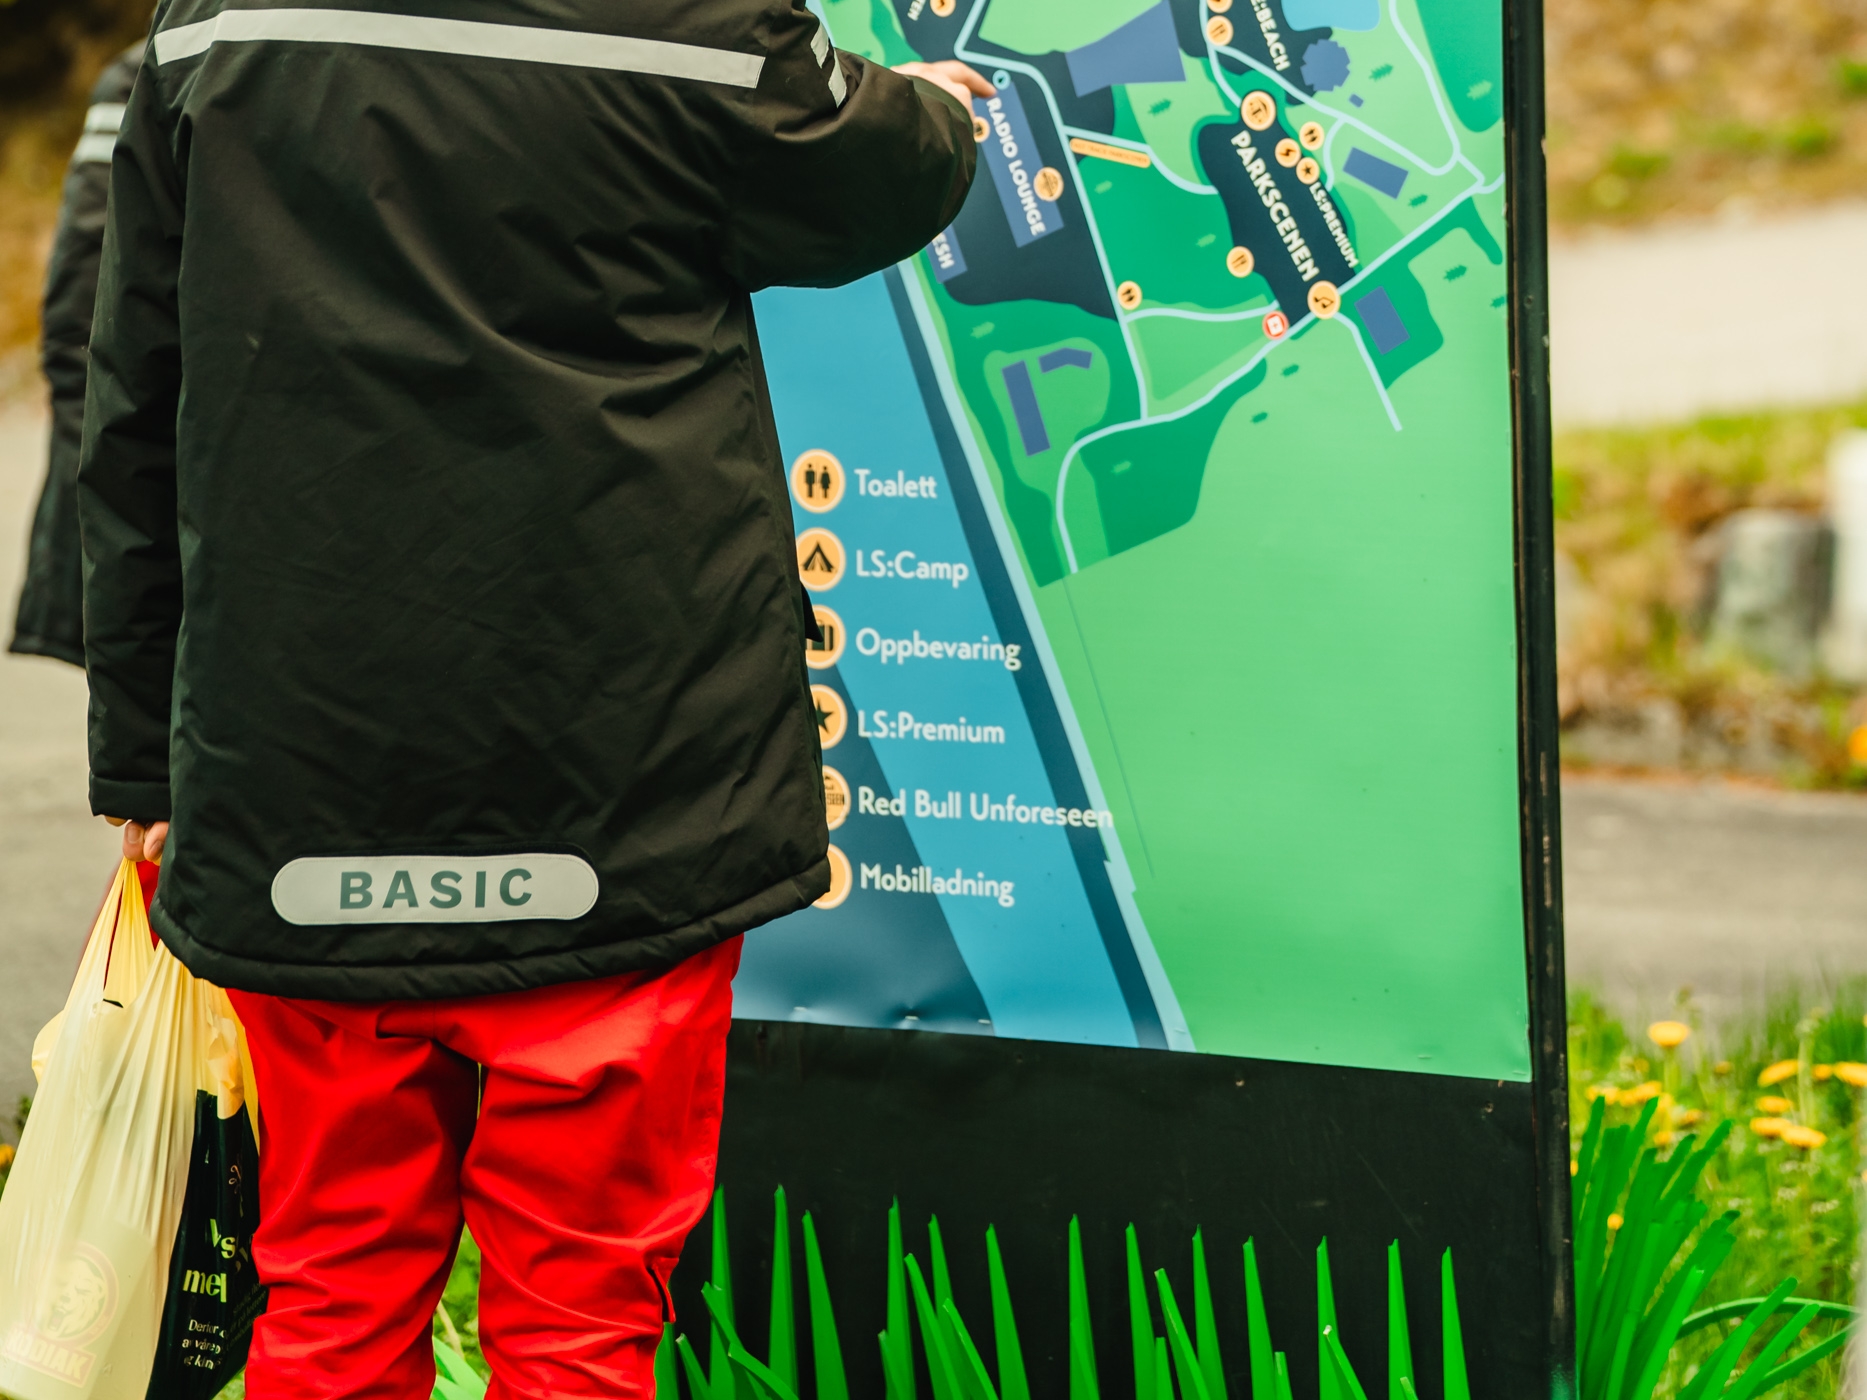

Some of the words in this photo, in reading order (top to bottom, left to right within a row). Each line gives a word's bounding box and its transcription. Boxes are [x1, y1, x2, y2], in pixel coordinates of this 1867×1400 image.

[986, 97, 1018, 158] RADIO
[1008, 160, 1046, 236] LOUNGE
[1231, 130, 1319, 283] PARKSCENEN
[1308, 182, 1360, 269] LS:PREMIUM
[855, 468, 938, 499] Toalett
[856, 550, 969, 588] LS:Camp
[855, 627, 1022, 670] Oppbevaring
[857, 710, 1006, 744] LS:Premium
[858, 786, 907, 816] Red
[914, 789, 962, 819] Bull
[970, 794, 1114, 828] Unforeseen
[339, 868, 533, 910] BASIC
[860, 864, 1015, 908] Mobilladning
